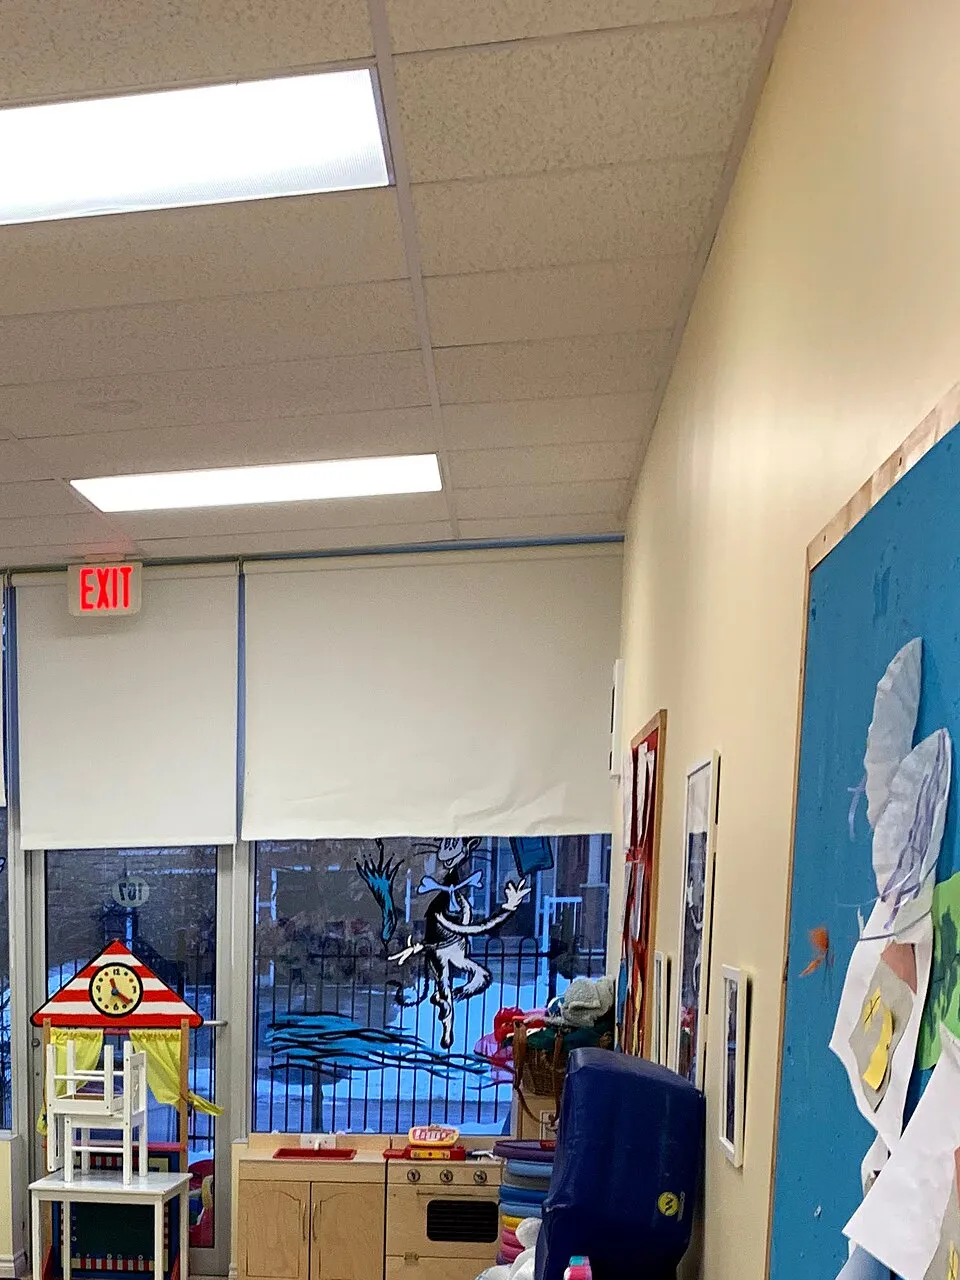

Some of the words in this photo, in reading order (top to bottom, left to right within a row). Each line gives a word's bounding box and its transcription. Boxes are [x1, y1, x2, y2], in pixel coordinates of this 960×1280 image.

[80, 566, 133, 611] EXIT
[113, 968, 121, 976] 12
[96, 985, 101, 993] 9
[132, 986, 137, 994] 3
[113, 1003, 119, 1011] 6
